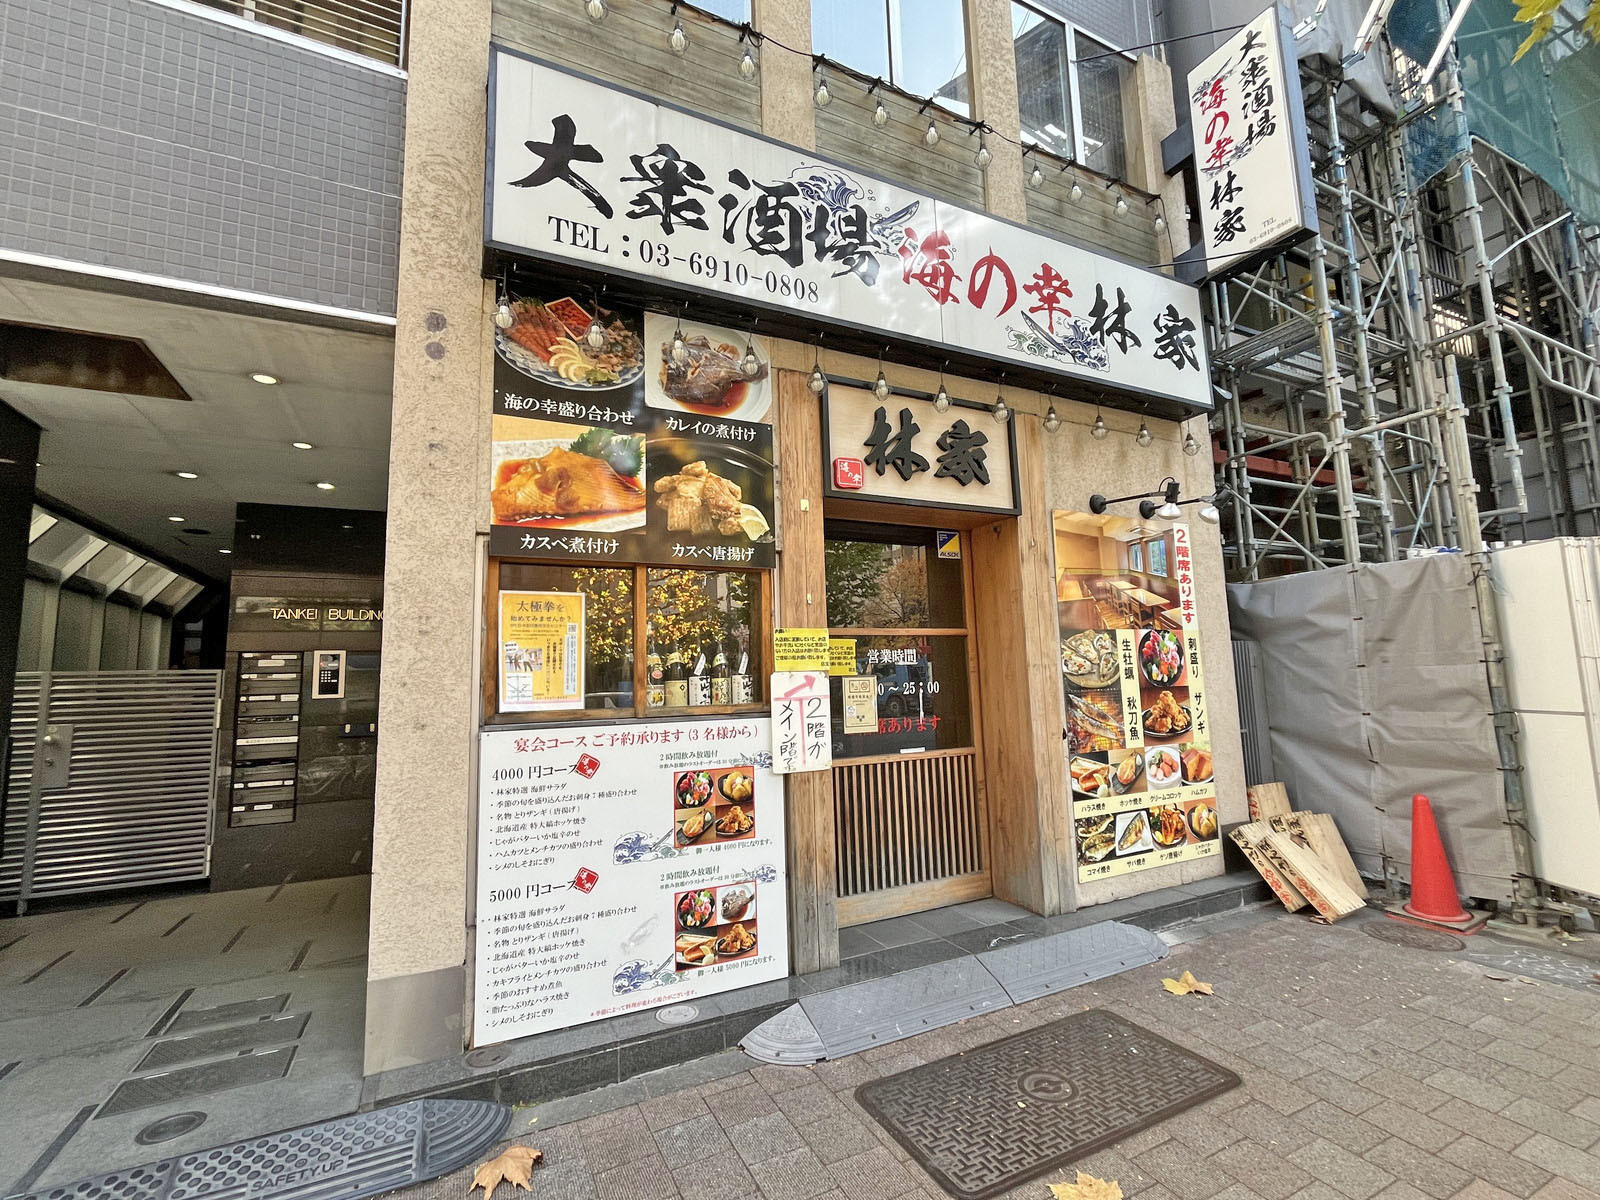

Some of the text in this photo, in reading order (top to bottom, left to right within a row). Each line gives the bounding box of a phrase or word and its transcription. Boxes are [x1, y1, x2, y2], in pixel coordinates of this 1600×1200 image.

[1210, 171, 1246, 248] 林家
[639, 238, 819, 303] 03-6910-0808
[1088, 282, 1201, 372] 林家
[504, 393, 635, 426] 海の幸盛り合わせ
[666, 416, 757, 441] カレイの煮付け
[864, 406, 991, 487] 林家
[520, 534, 620, 555] カスベ煮付け
[671, 543, 755, 562] カスベ唐揚げ
[271, 608, 384, 621] TANKEI BUILDIN
[867, 649, 918, 664] 営業時間
[1187, 637, 1199, 678] 刺盛り
[1126, 696, 1140, 740] 秋刀魚
[514, 735, 588, 753] 宴会コース
[1081, 802, 1106, 812] ハラス焼き
[1119, 797, 1142, 807] ホッケ焼き
[1149, 792, 1182, 803] クリームコロッケ
[1087, 866, 1111, 876] コマイ焼き
[1126, 857, 1146, 868] サバ焼き
